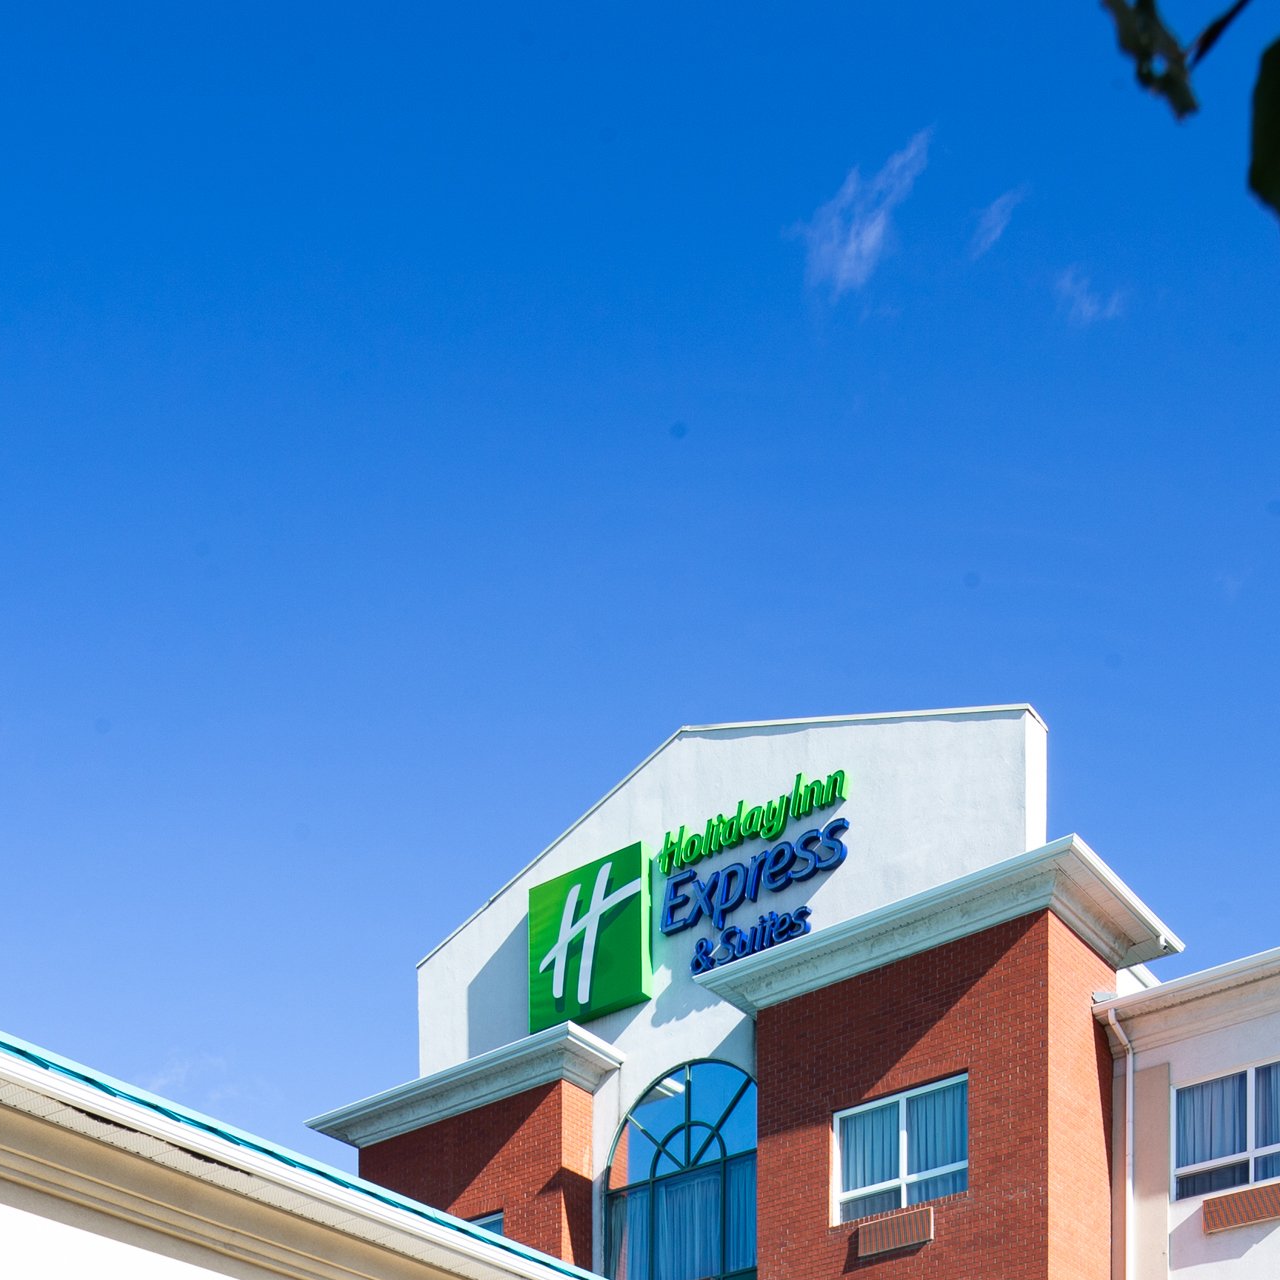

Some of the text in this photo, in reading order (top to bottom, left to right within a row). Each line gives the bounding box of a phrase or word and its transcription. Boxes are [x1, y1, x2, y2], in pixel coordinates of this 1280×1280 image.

[658, 769, 847, 875] Holiday Inn
[660, 818, 850, 935] Express
[690, 906, 812, 975] & Suites
